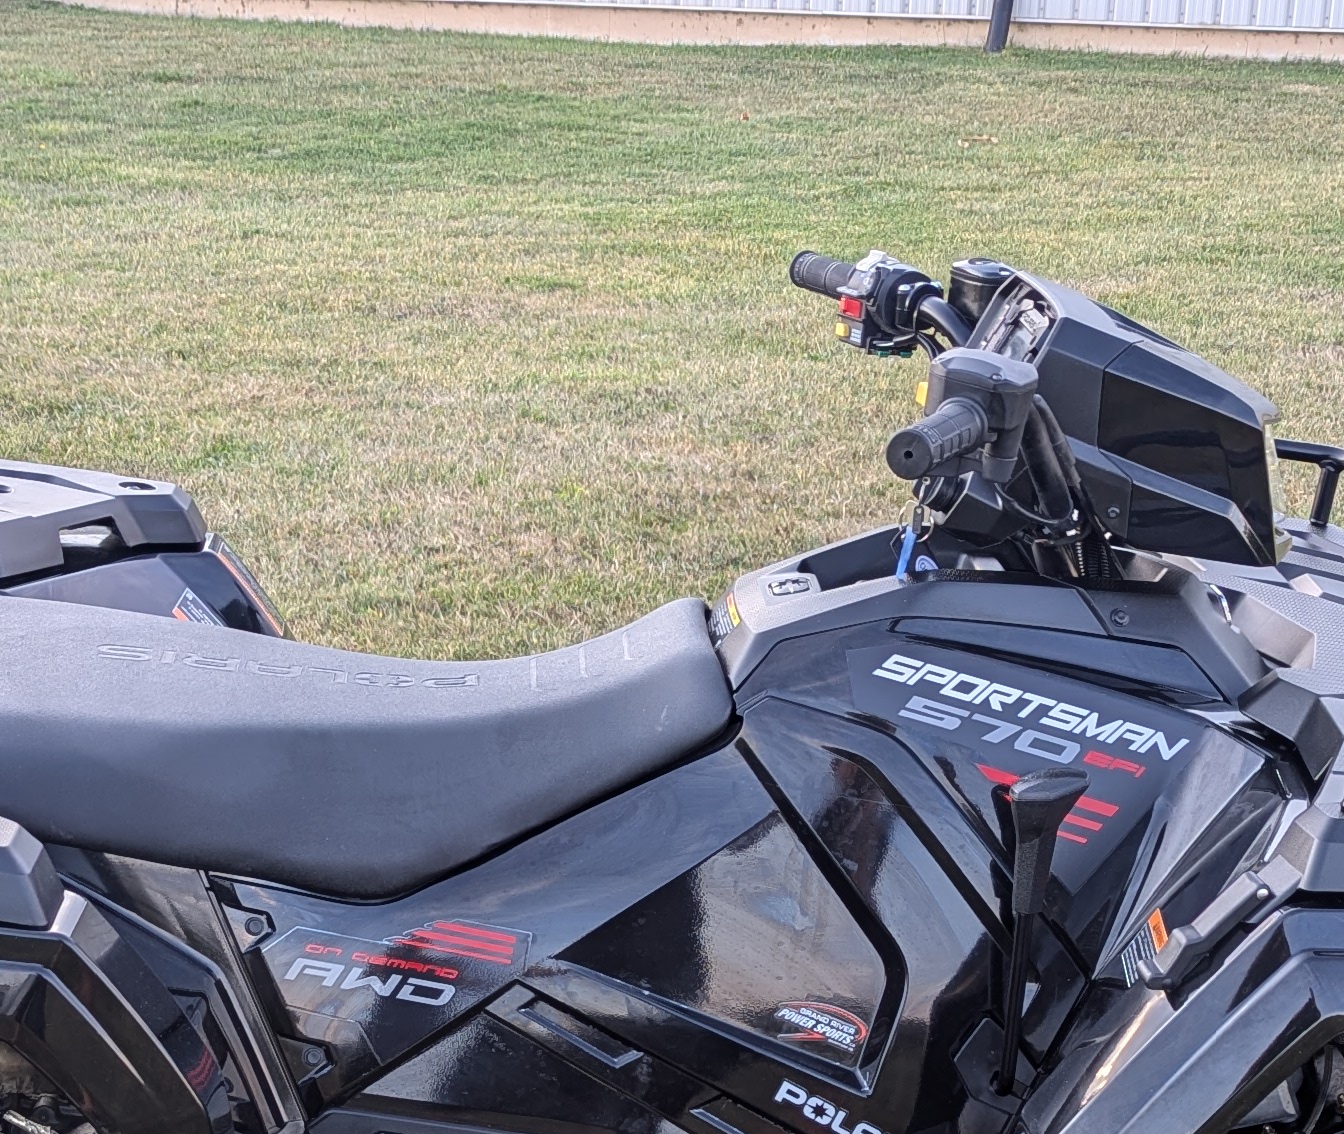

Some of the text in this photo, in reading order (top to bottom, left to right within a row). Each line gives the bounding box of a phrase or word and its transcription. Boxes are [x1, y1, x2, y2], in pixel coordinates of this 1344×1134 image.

[872, 653, 1190, 761] SPORTSMAN
[898, 695, 1146, 778] 570 EFI
[283, 957, 456, 1006] AWD
[777, 1008, 816, 1029] POWER
[799, 1007, 856, 1035] GRAND RIVER
